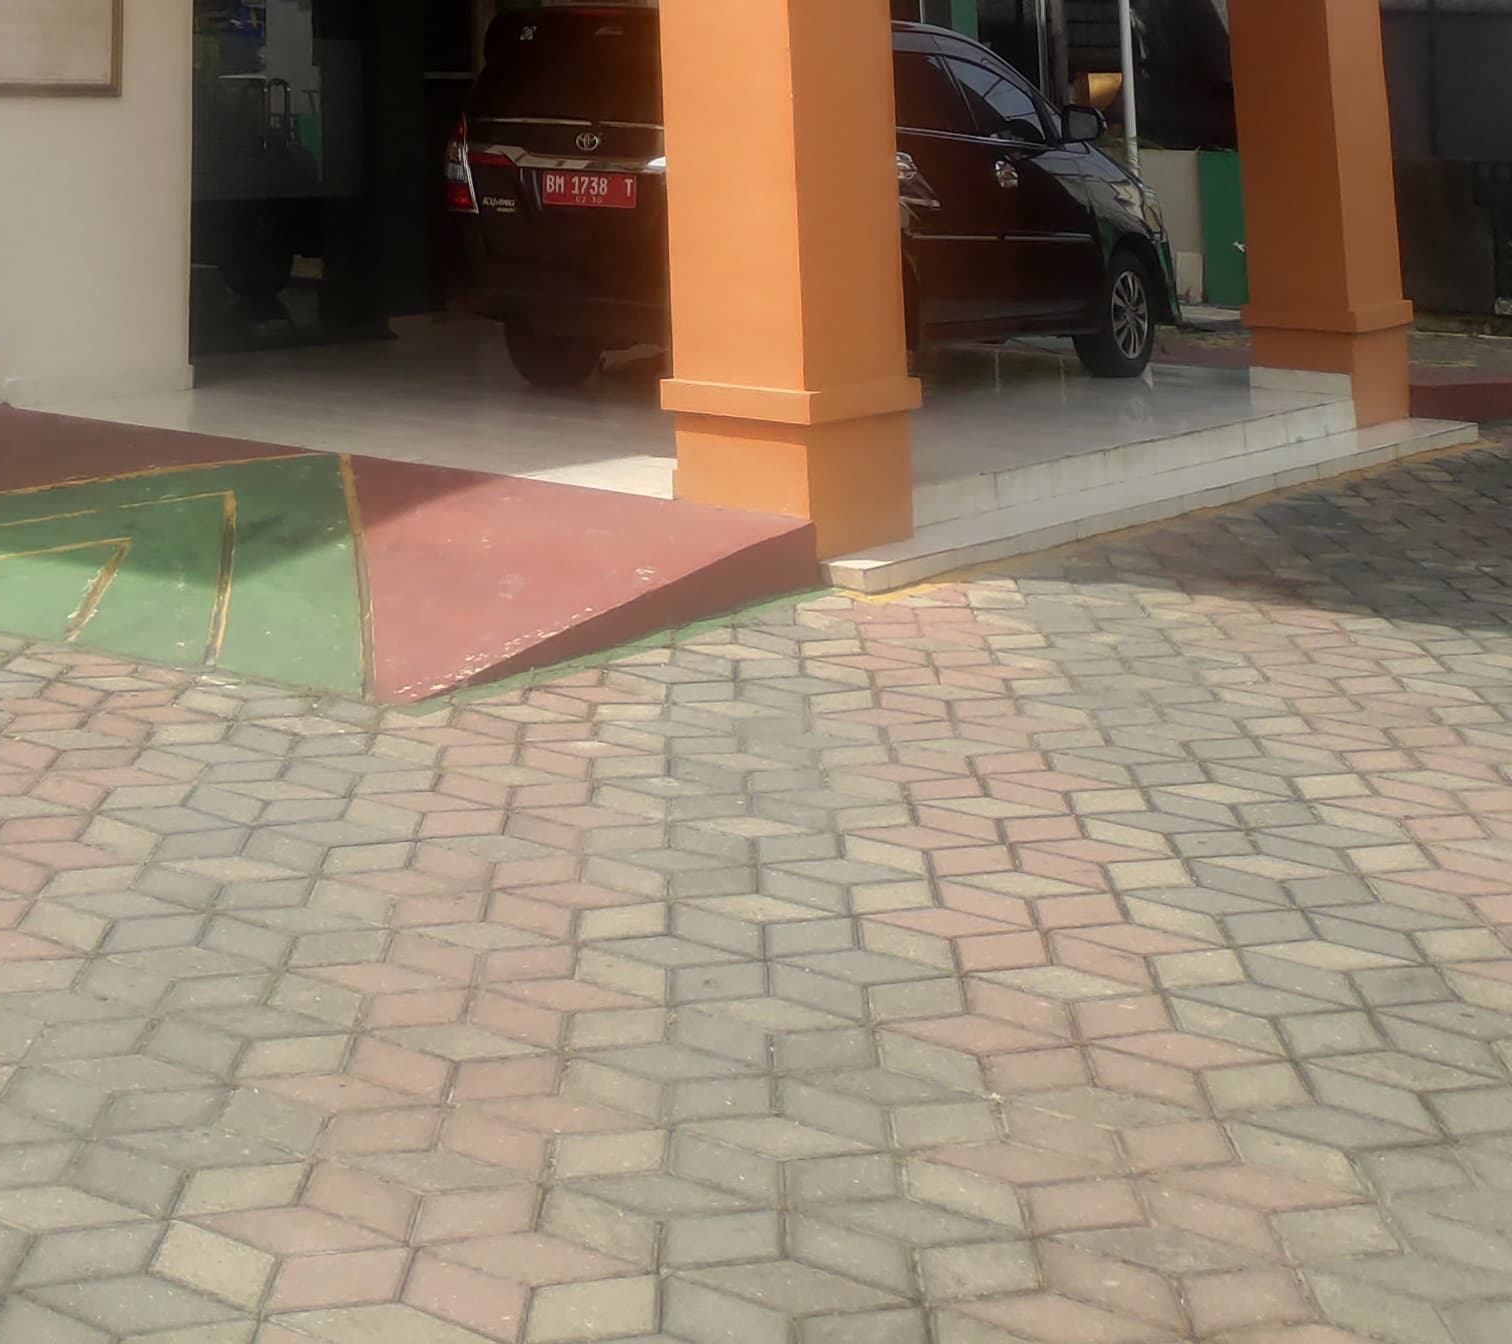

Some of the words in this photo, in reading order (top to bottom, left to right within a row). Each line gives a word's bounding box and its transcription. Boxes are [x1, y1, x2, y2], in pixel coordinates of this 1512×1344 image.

[546, 174, 565, 194] BM
[571, 175, 608, 196] 1738
[624, 178, 634, 198] T
